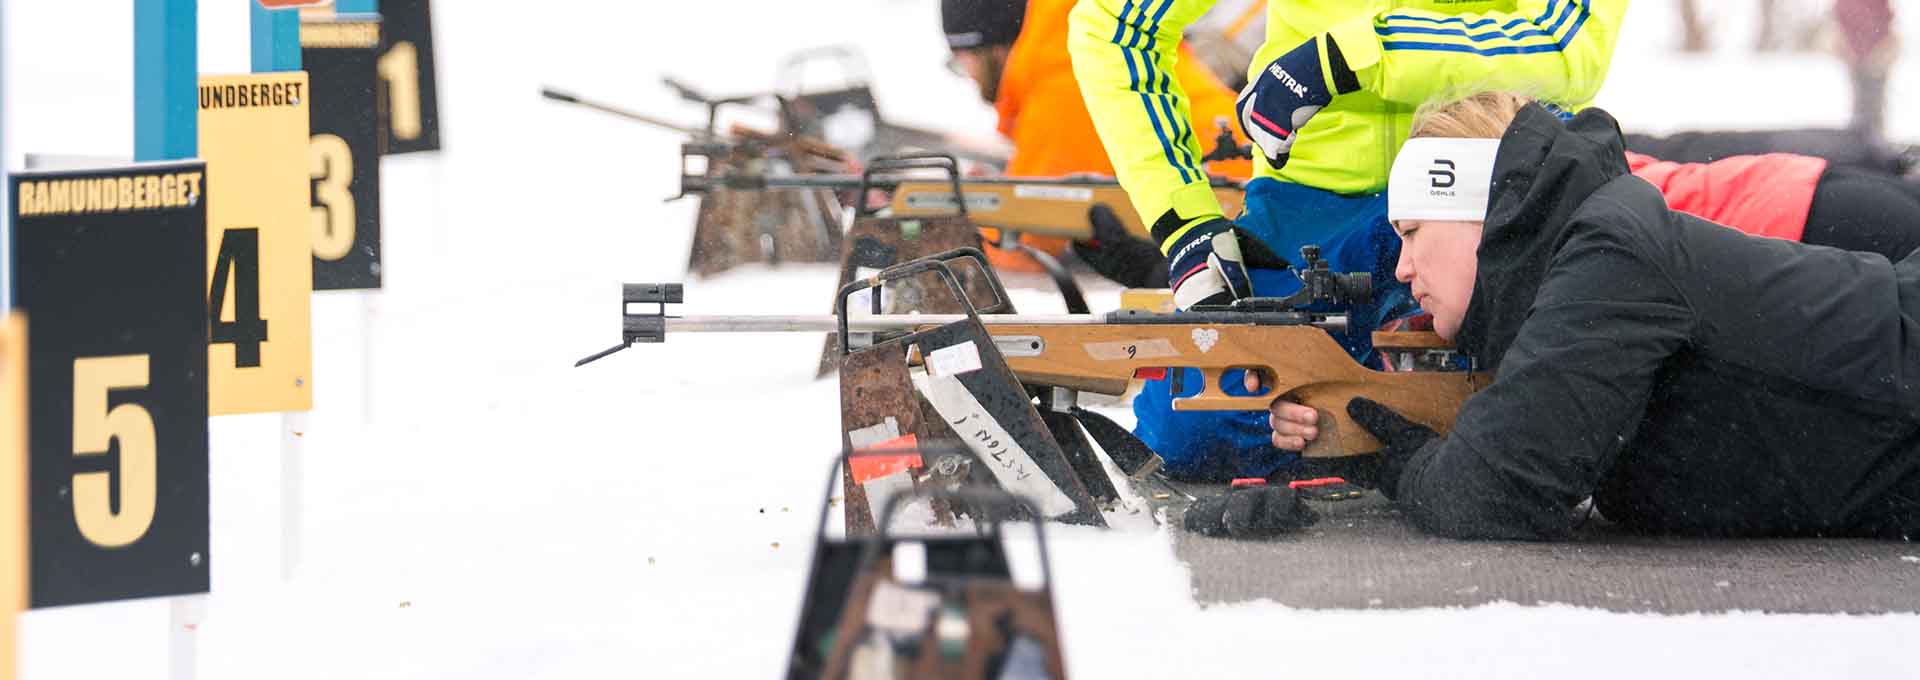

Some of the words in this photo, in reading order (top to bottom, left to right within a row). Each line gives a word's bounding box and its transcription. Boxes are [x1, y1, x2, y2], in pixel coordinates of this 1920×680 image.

[197, 82, 302, 109] UNDBERGET
[376, 40, 421, 141] 1
[1268, 62, 1305, 98] HESTRA
[18, 172, 202, 216] RAMUNDBERGET
[309, 132, 356, 261] 3
[208, 227, 268, 368] 4
[72, 353, 157, 548] 5
